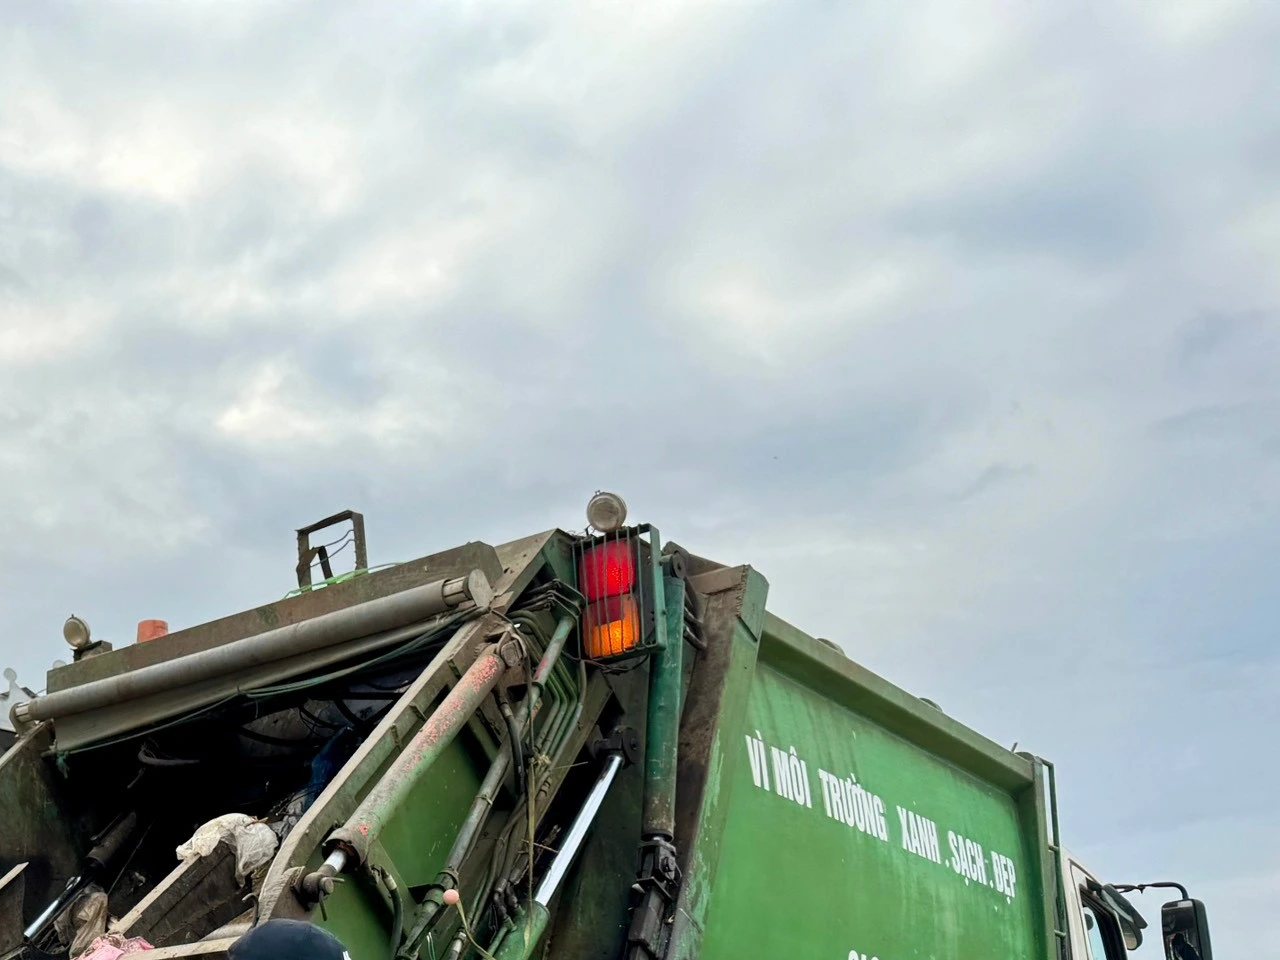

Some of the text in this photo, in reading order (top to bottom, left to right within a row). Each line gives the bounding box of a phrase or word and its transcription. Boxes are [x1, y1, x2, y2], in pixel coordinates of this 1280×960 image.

[745, 729, 770, 791] VÌ
[771, 745, 812, 808] MÔI
[818, 768, 888, 842] TRƯỜNG
[990, 850, 1016, 904] ĐẸP
